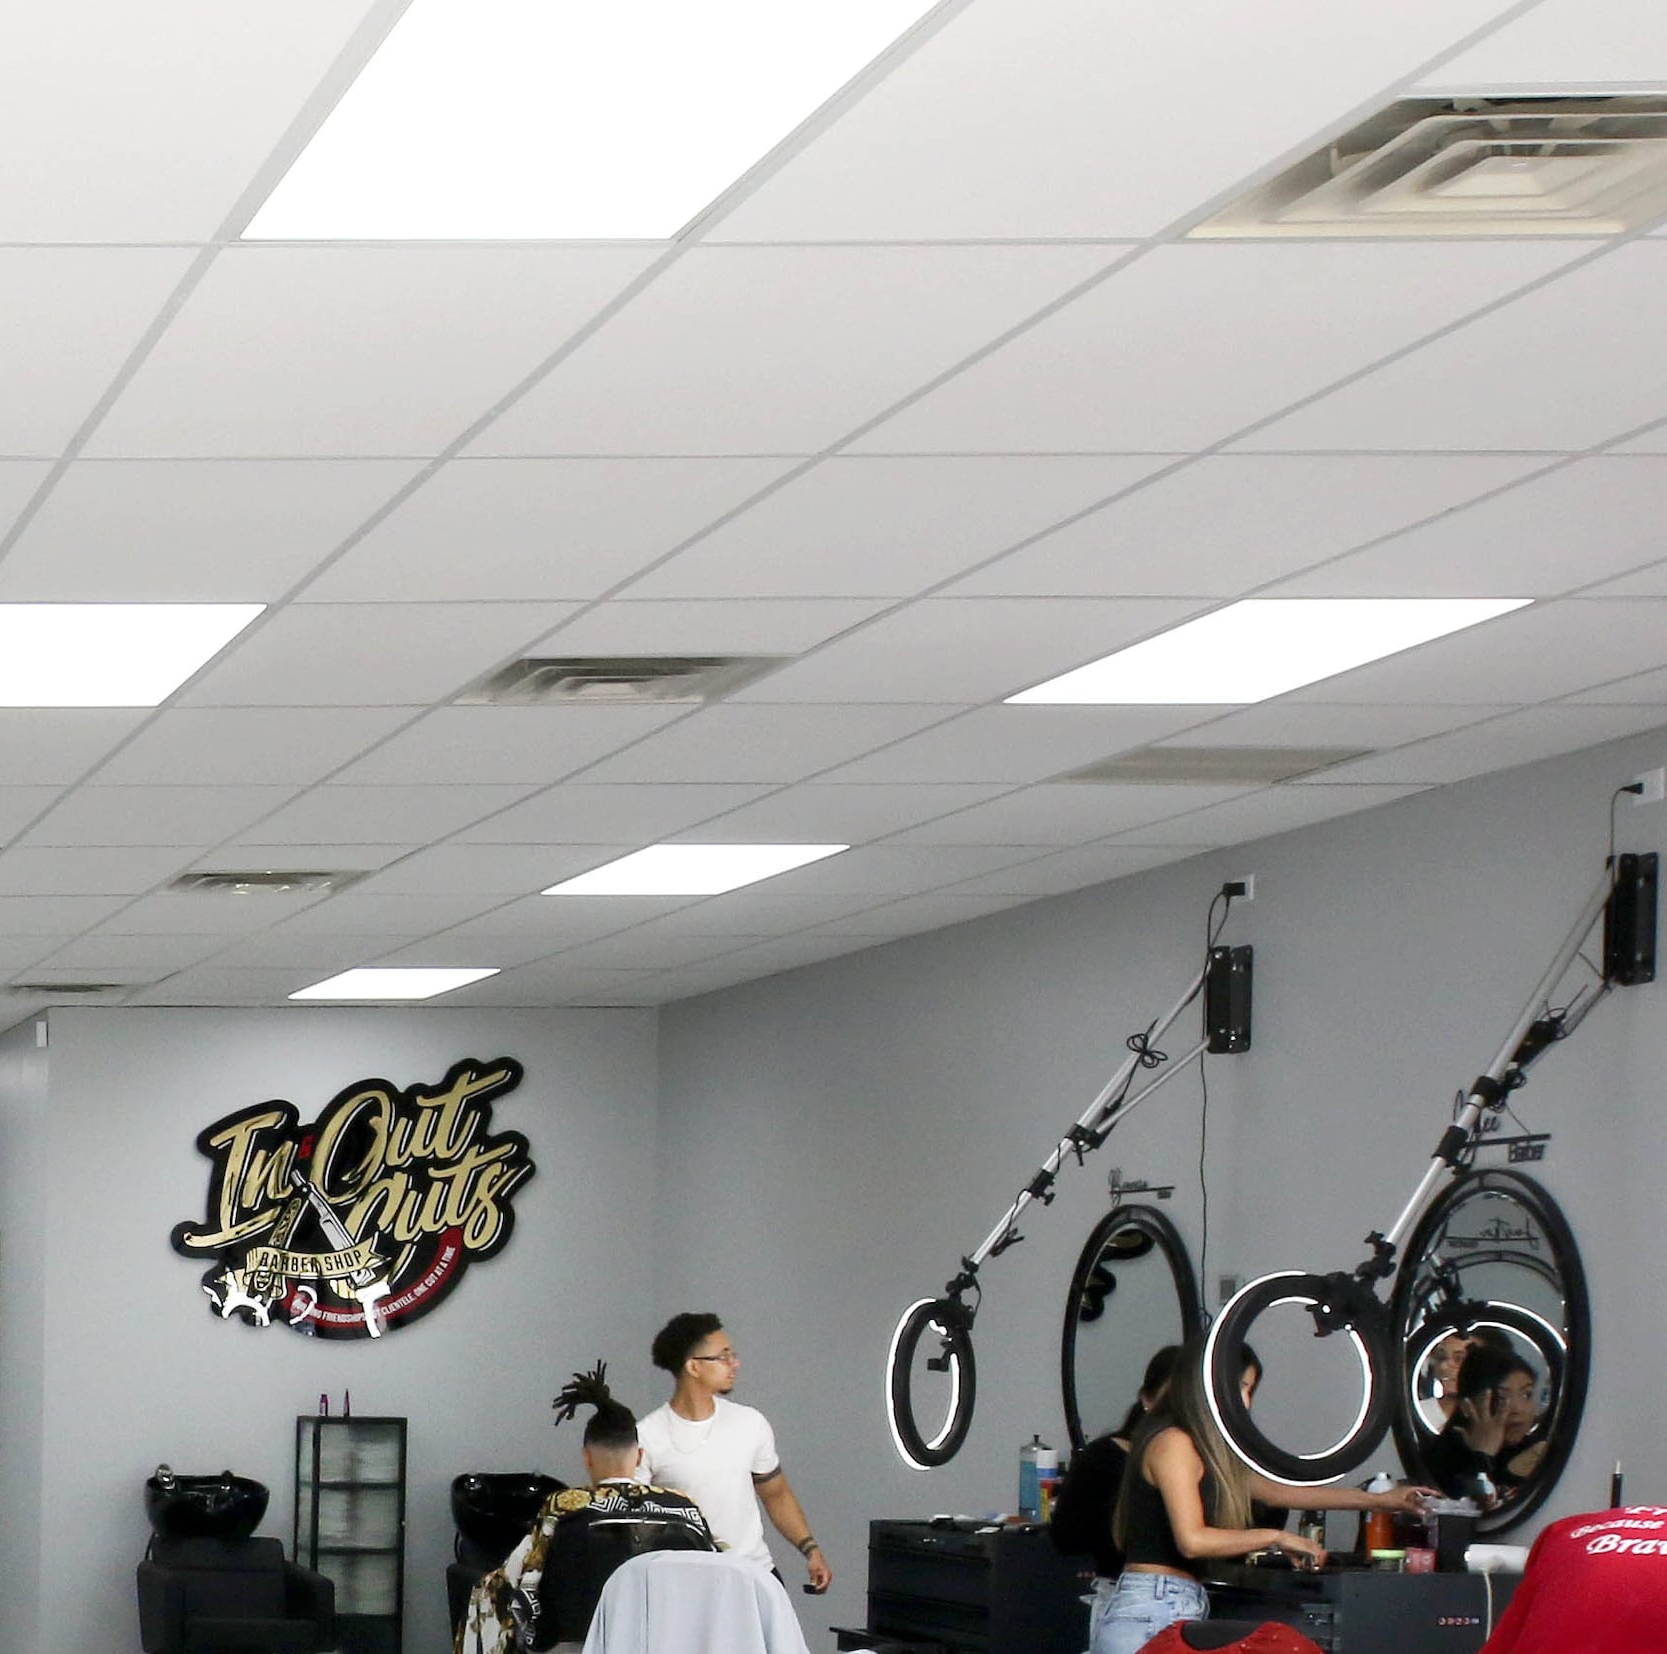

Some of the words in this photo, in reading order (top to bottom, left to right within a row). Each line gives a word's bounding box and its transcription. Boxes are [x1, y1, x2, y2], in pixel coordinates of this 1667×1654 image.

[183, 1110, 299, 1248] In
[312, 1069, 513, 1204] Out
[260, 1249, 319, 1273] BARBER
[325, 1249, 363, 1272] SHOP
[1570, 1519, 1666, 1539] Because
